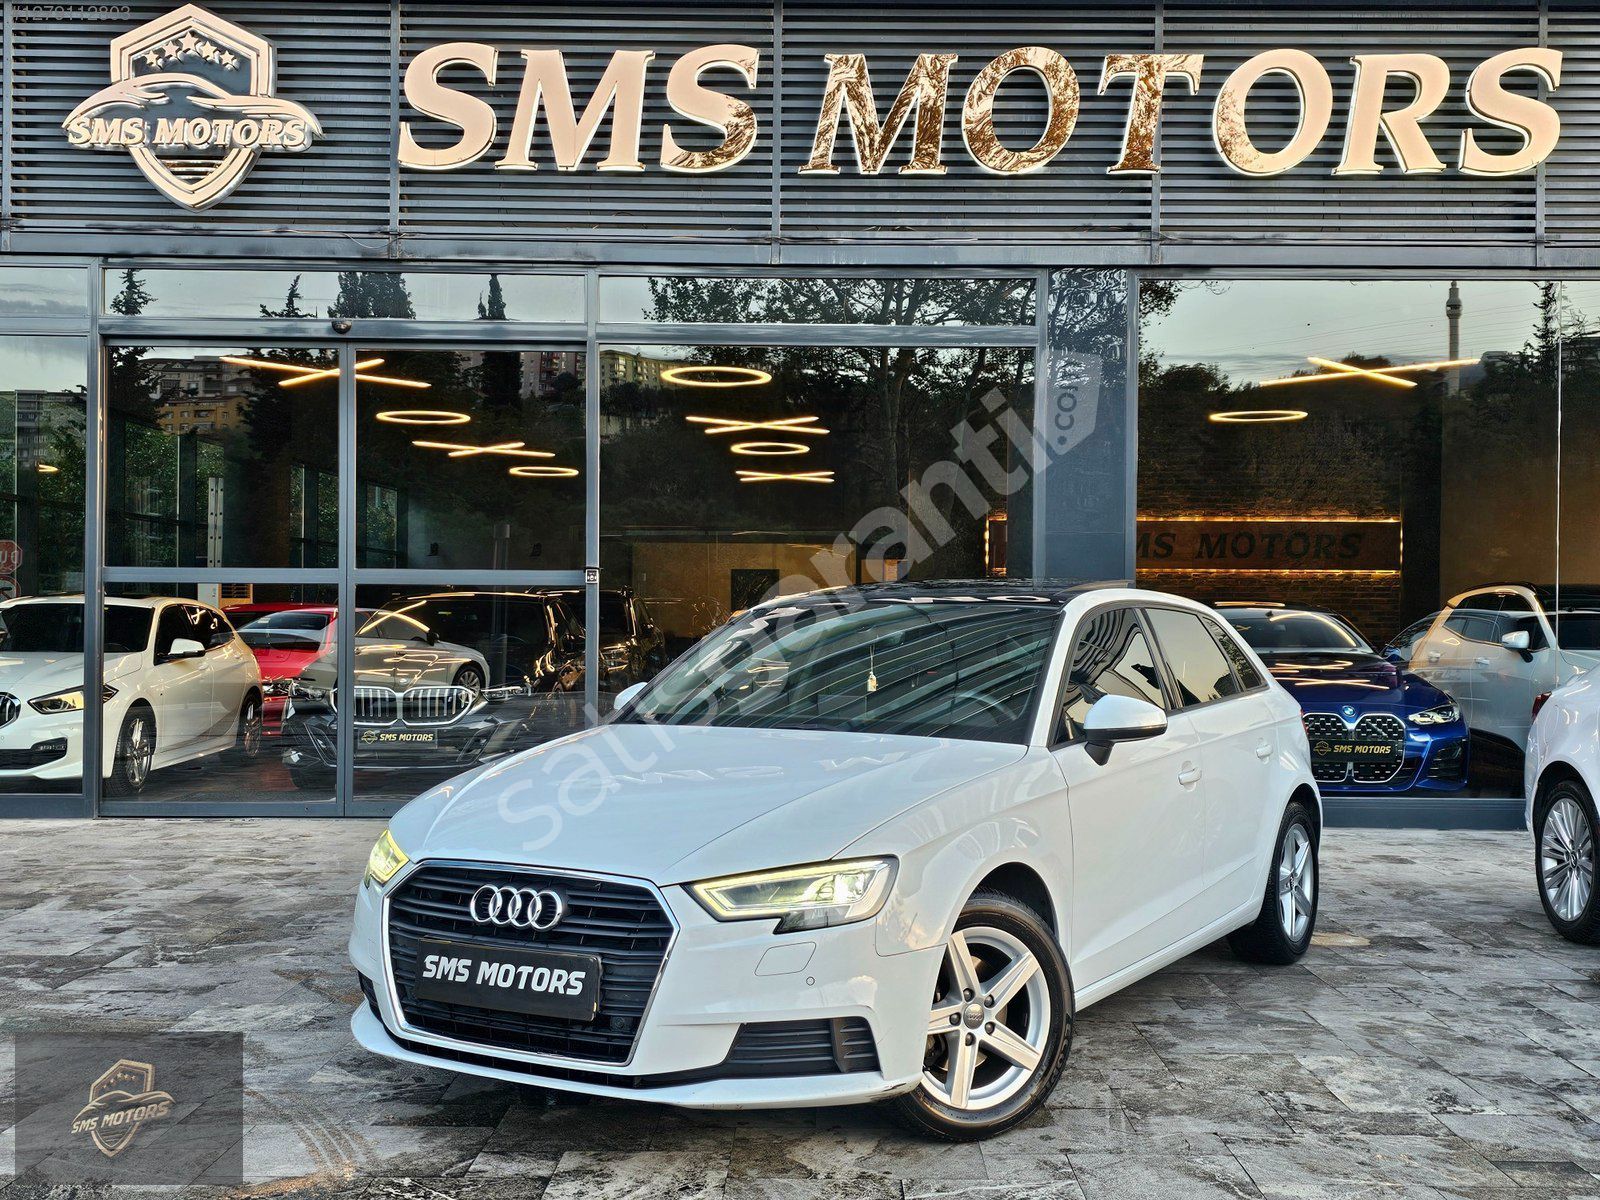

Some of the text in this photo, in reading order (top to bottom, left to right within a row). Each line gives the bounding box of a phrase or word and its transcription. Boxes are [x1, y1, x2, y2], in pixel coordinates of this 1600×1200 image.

[397, 42, 1564, 177] SMS MOTORS
[68, 117, 310, 147] SMS MOTORS
[1194, 530, 1364, 560] MOTORS
[379, 733, 397, 742] SMS
[398, 733, 434, 742] MOTORS
[1333, 744, 1353, 753] SMS
[1354, 745, 1392, 754] MOTORS
[422, 954, 587, 996] SMS MOTORS
